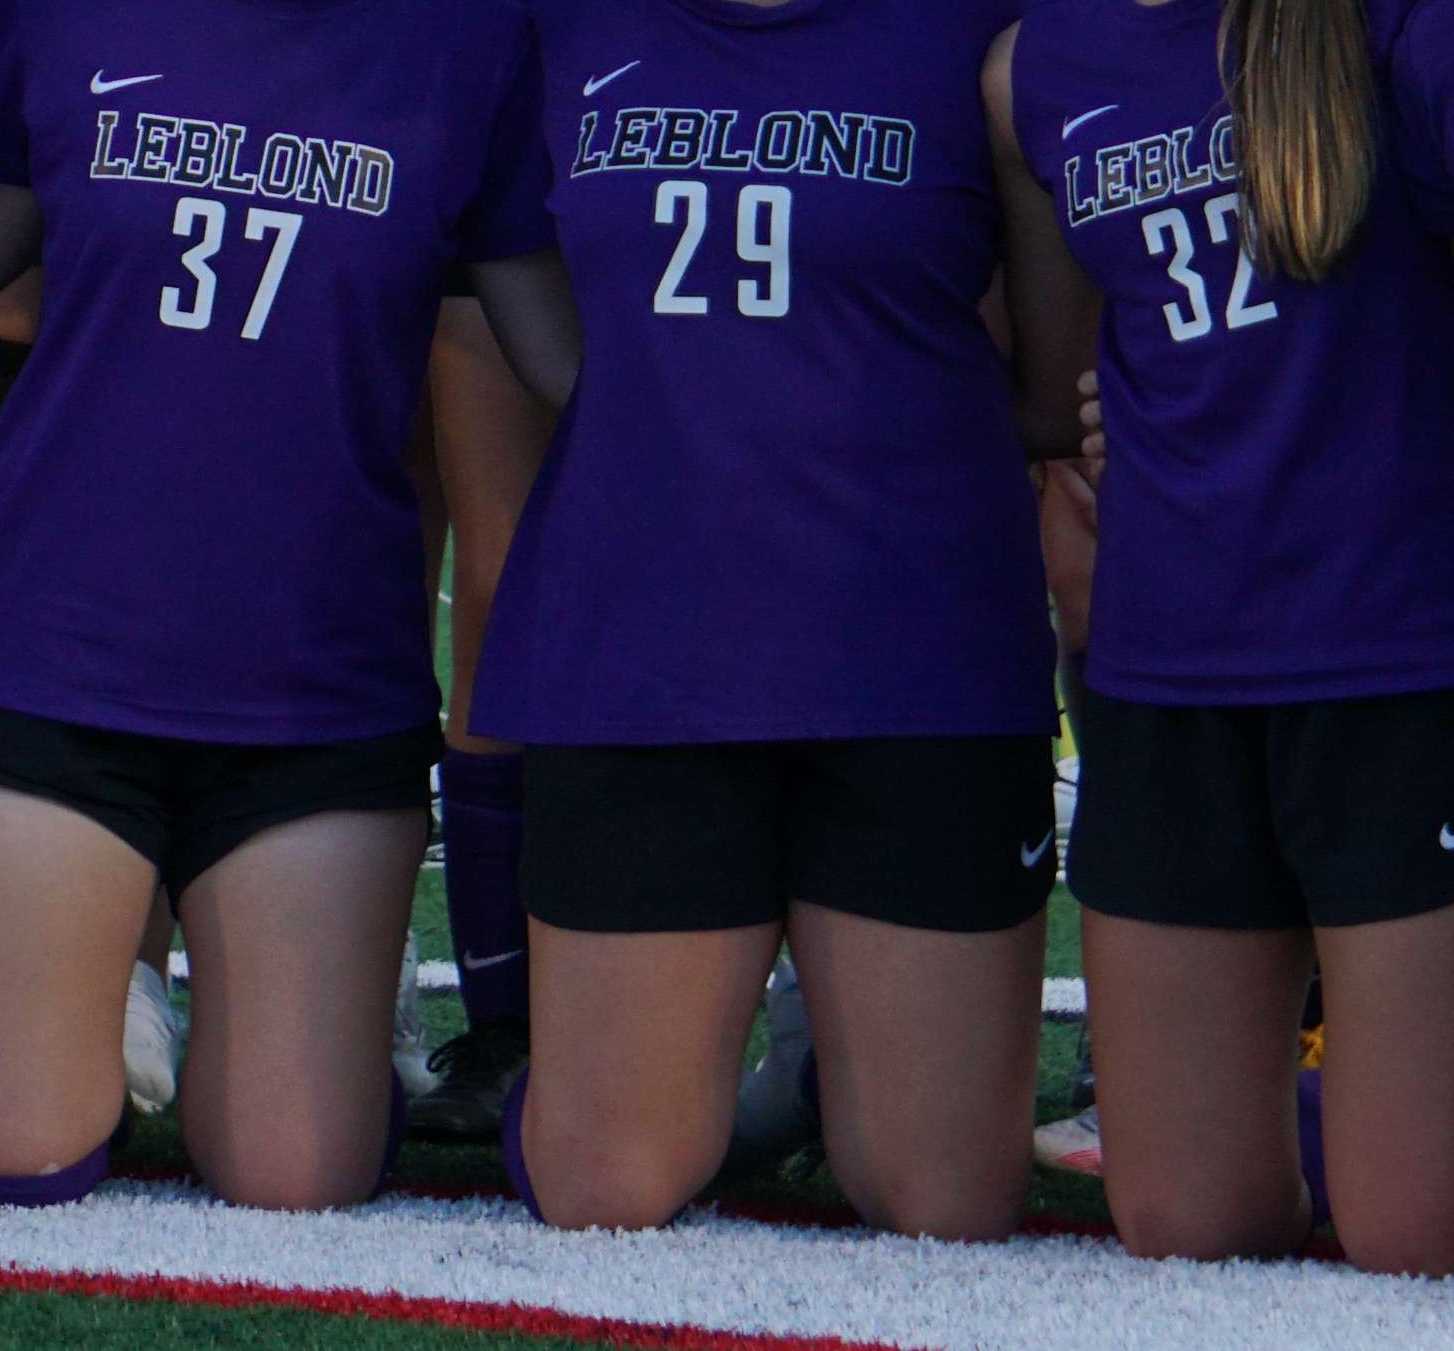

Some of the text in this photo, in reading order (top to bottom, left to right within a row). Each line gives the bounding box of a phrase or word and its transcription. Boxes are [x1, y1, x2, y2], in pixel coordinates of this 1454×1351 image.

[89, 110, 395, 217] LEBLOND
[569, 106, 916, 187] LEBLOND
[159, 196, 304, 340] 37
[653, 180, 793, 318] 29
[1141, 192, 1279, 342] 32
